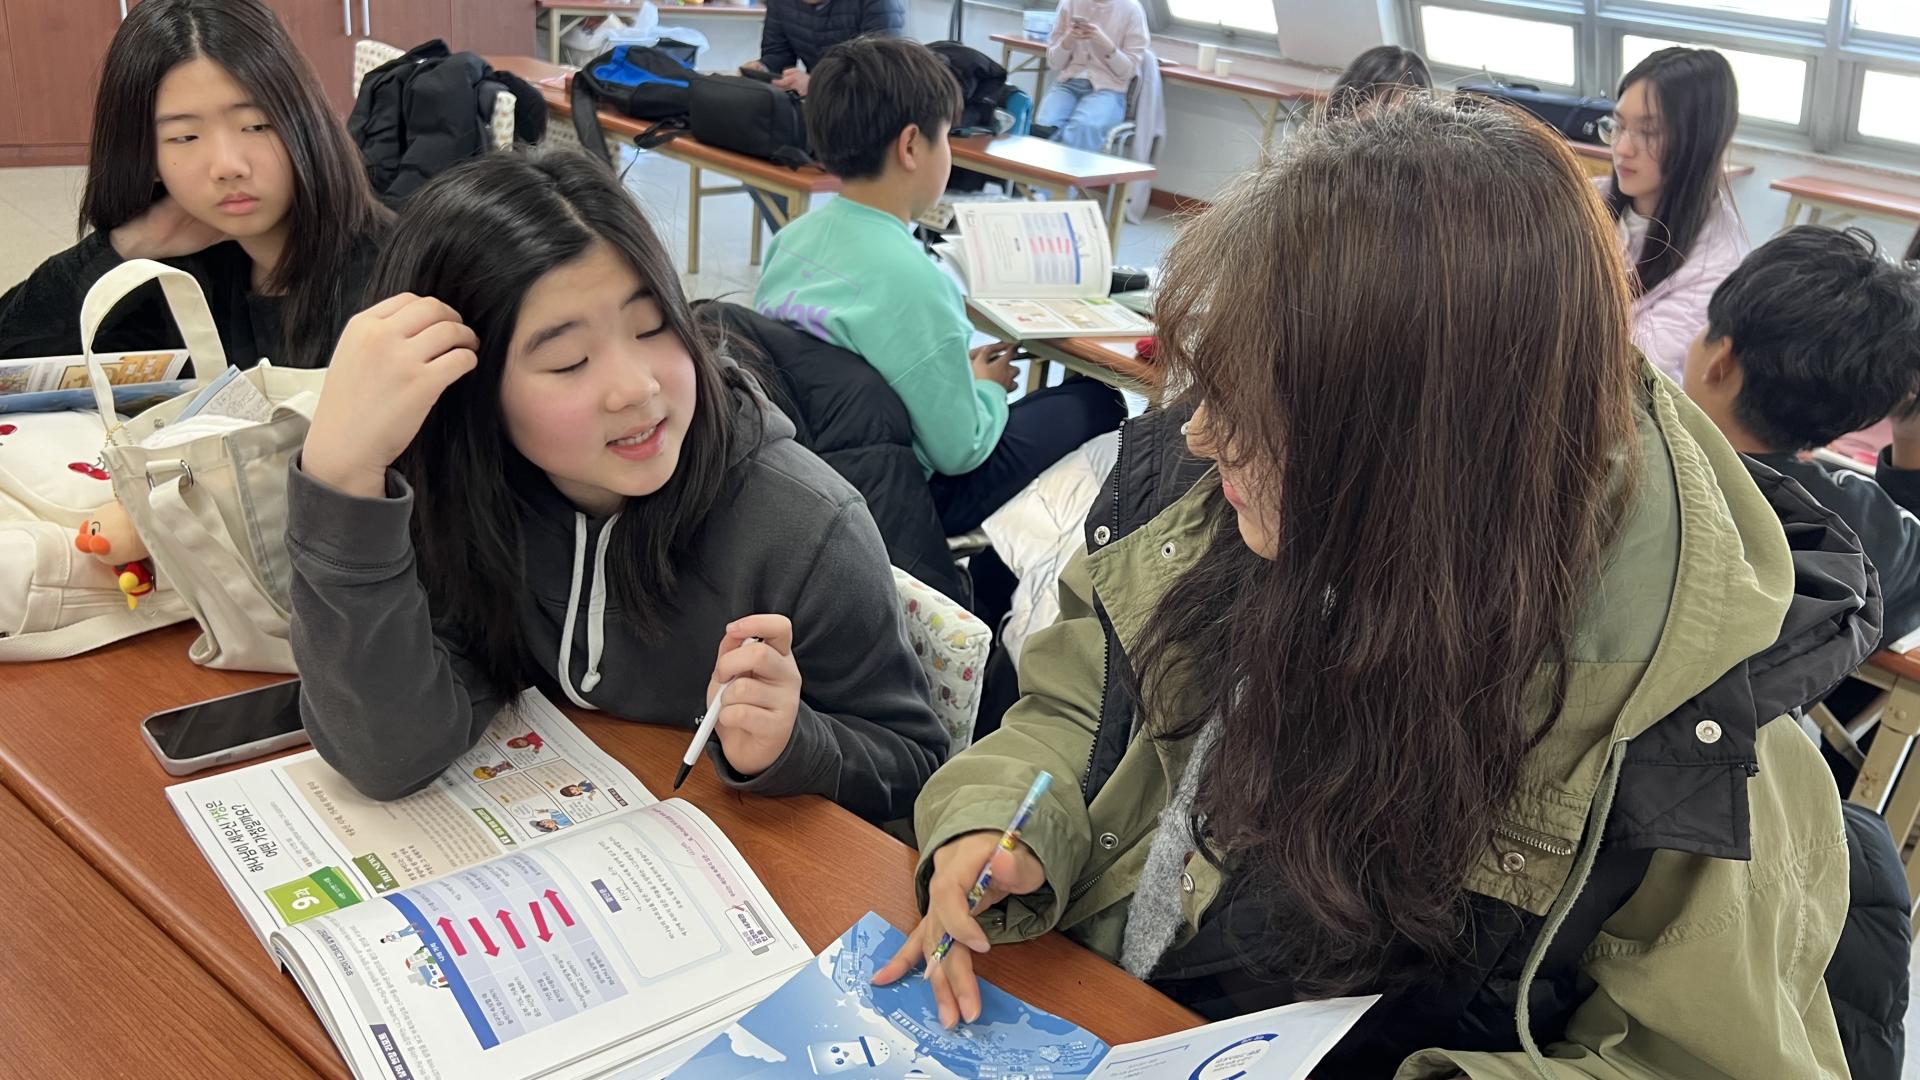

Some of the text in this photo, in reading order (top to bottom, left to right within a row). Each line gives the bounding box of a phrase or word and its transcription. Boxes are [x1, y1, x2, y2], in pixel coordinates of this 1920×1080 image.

[205, 800, 263, 873] 하나님이 세우신 가정은
[231, 804, 277, 857] 어떤 가정일까요?
[365, 854, 392, 882] HOT NEWS
[292, 885, 320, 910] 9과
[737, 912, 761, 943] 성경적 세계관
[340, 961, 353, 975] 무엇이
[377, 1031, 393, 1051] 리포트
[387, 1049, 401, 1065] 현장
